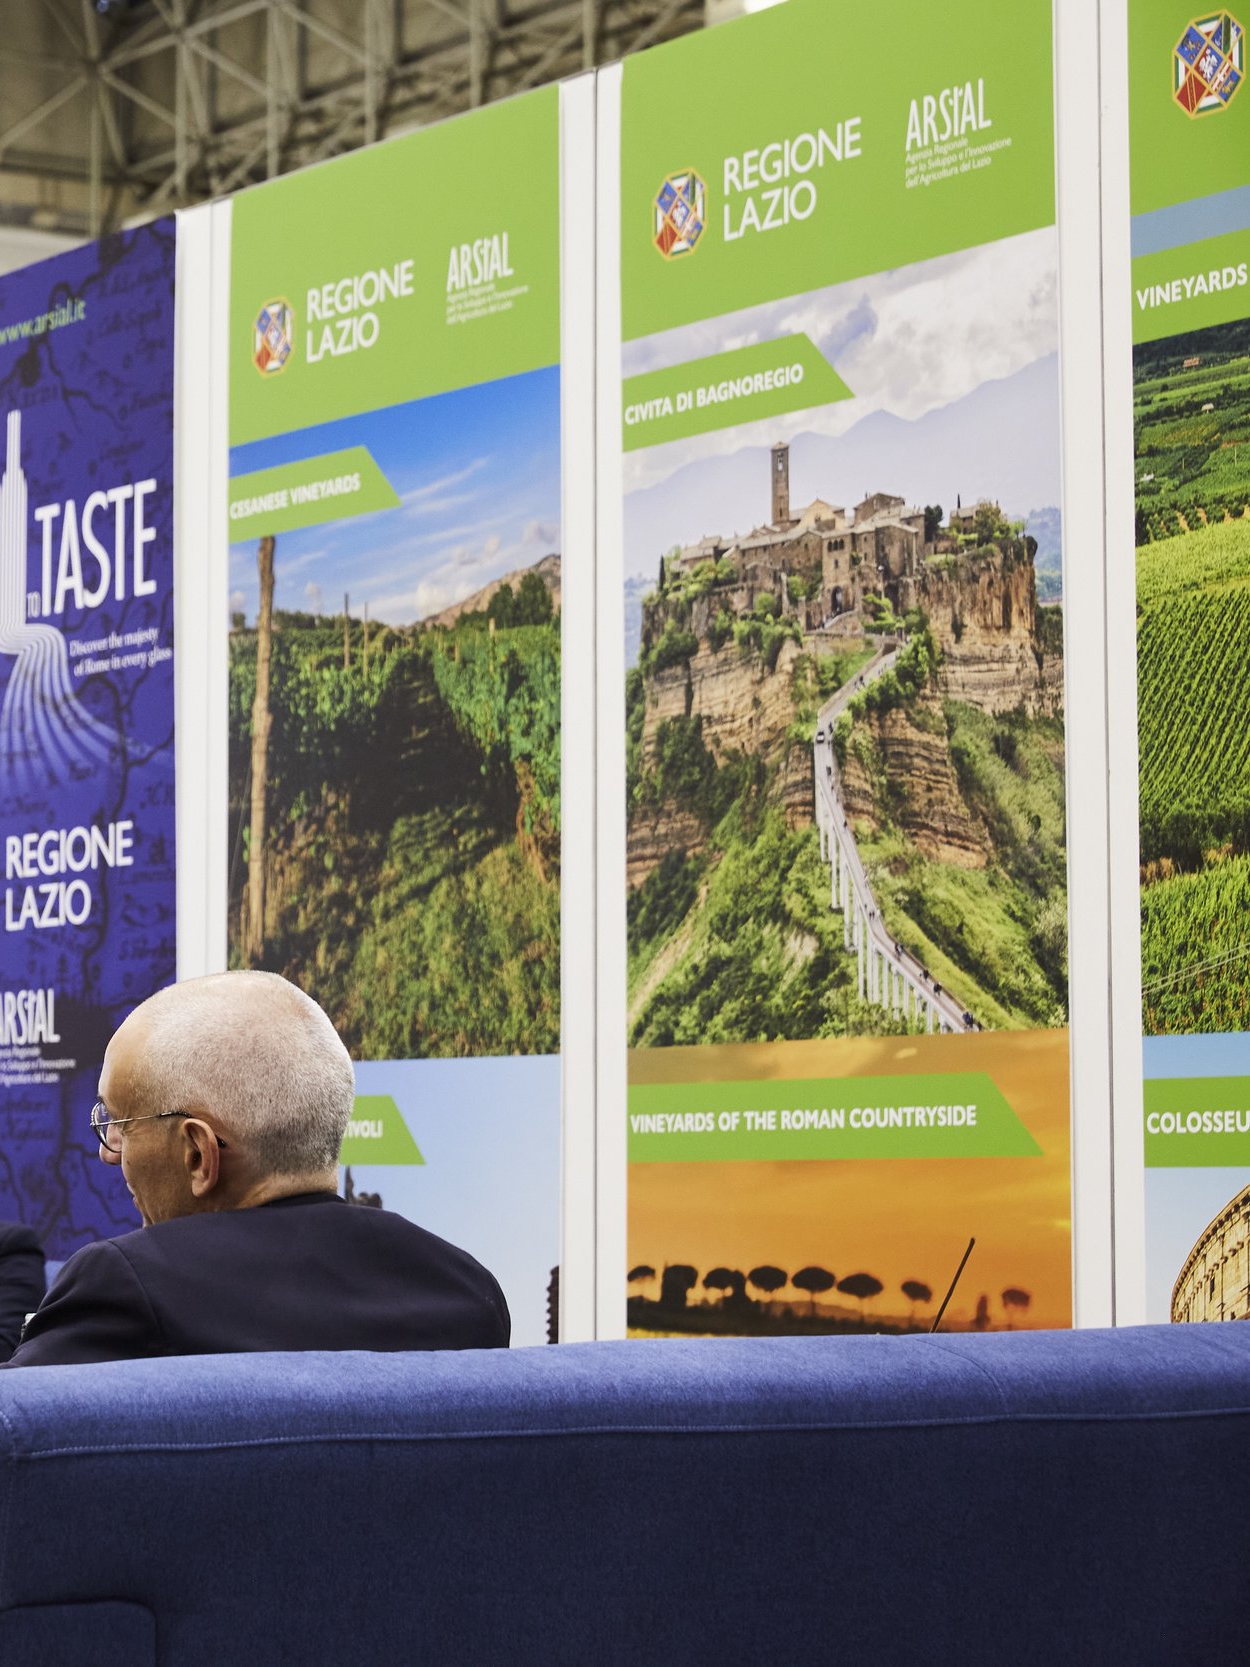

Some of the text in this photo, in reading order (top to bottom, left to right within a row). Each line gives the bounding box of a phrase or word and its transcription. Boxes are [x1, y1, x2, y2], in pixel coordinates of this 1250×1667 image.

[905, 78, 992, 152] ARSIAL
[723, 116, 862, 196] REGIONE
[723, 180, 817, 242] LAZIO
[446, 231, 514, 293] ARSIAL
[1136, 263, 1248, 311] VINEYARDS
[307, 259, 414, 323] REGIONE
[307, 312, 380, 363] LAZIO
[624, 363, 804, 425] CIVITA DI BAGNOREGIO
[229, 472, 361, 520] CESANESE VINEYARDS
[27, 591, 41, 617] TO
[34, 478, 157, 617] TASTE
[69, 627, 159, 657] Discover the majesty
[73, 645, 172, 677] of Rome in every glass
[6, 820, 134, 880] REGIONE
[6, 879, 92, 932] LAZIO
[630, 1105, 978, 1134] VINEYARDS OF THE ROMAN COUNTRYSIDE
[1146, 1110, 1250, 1134] COLOSSEU
